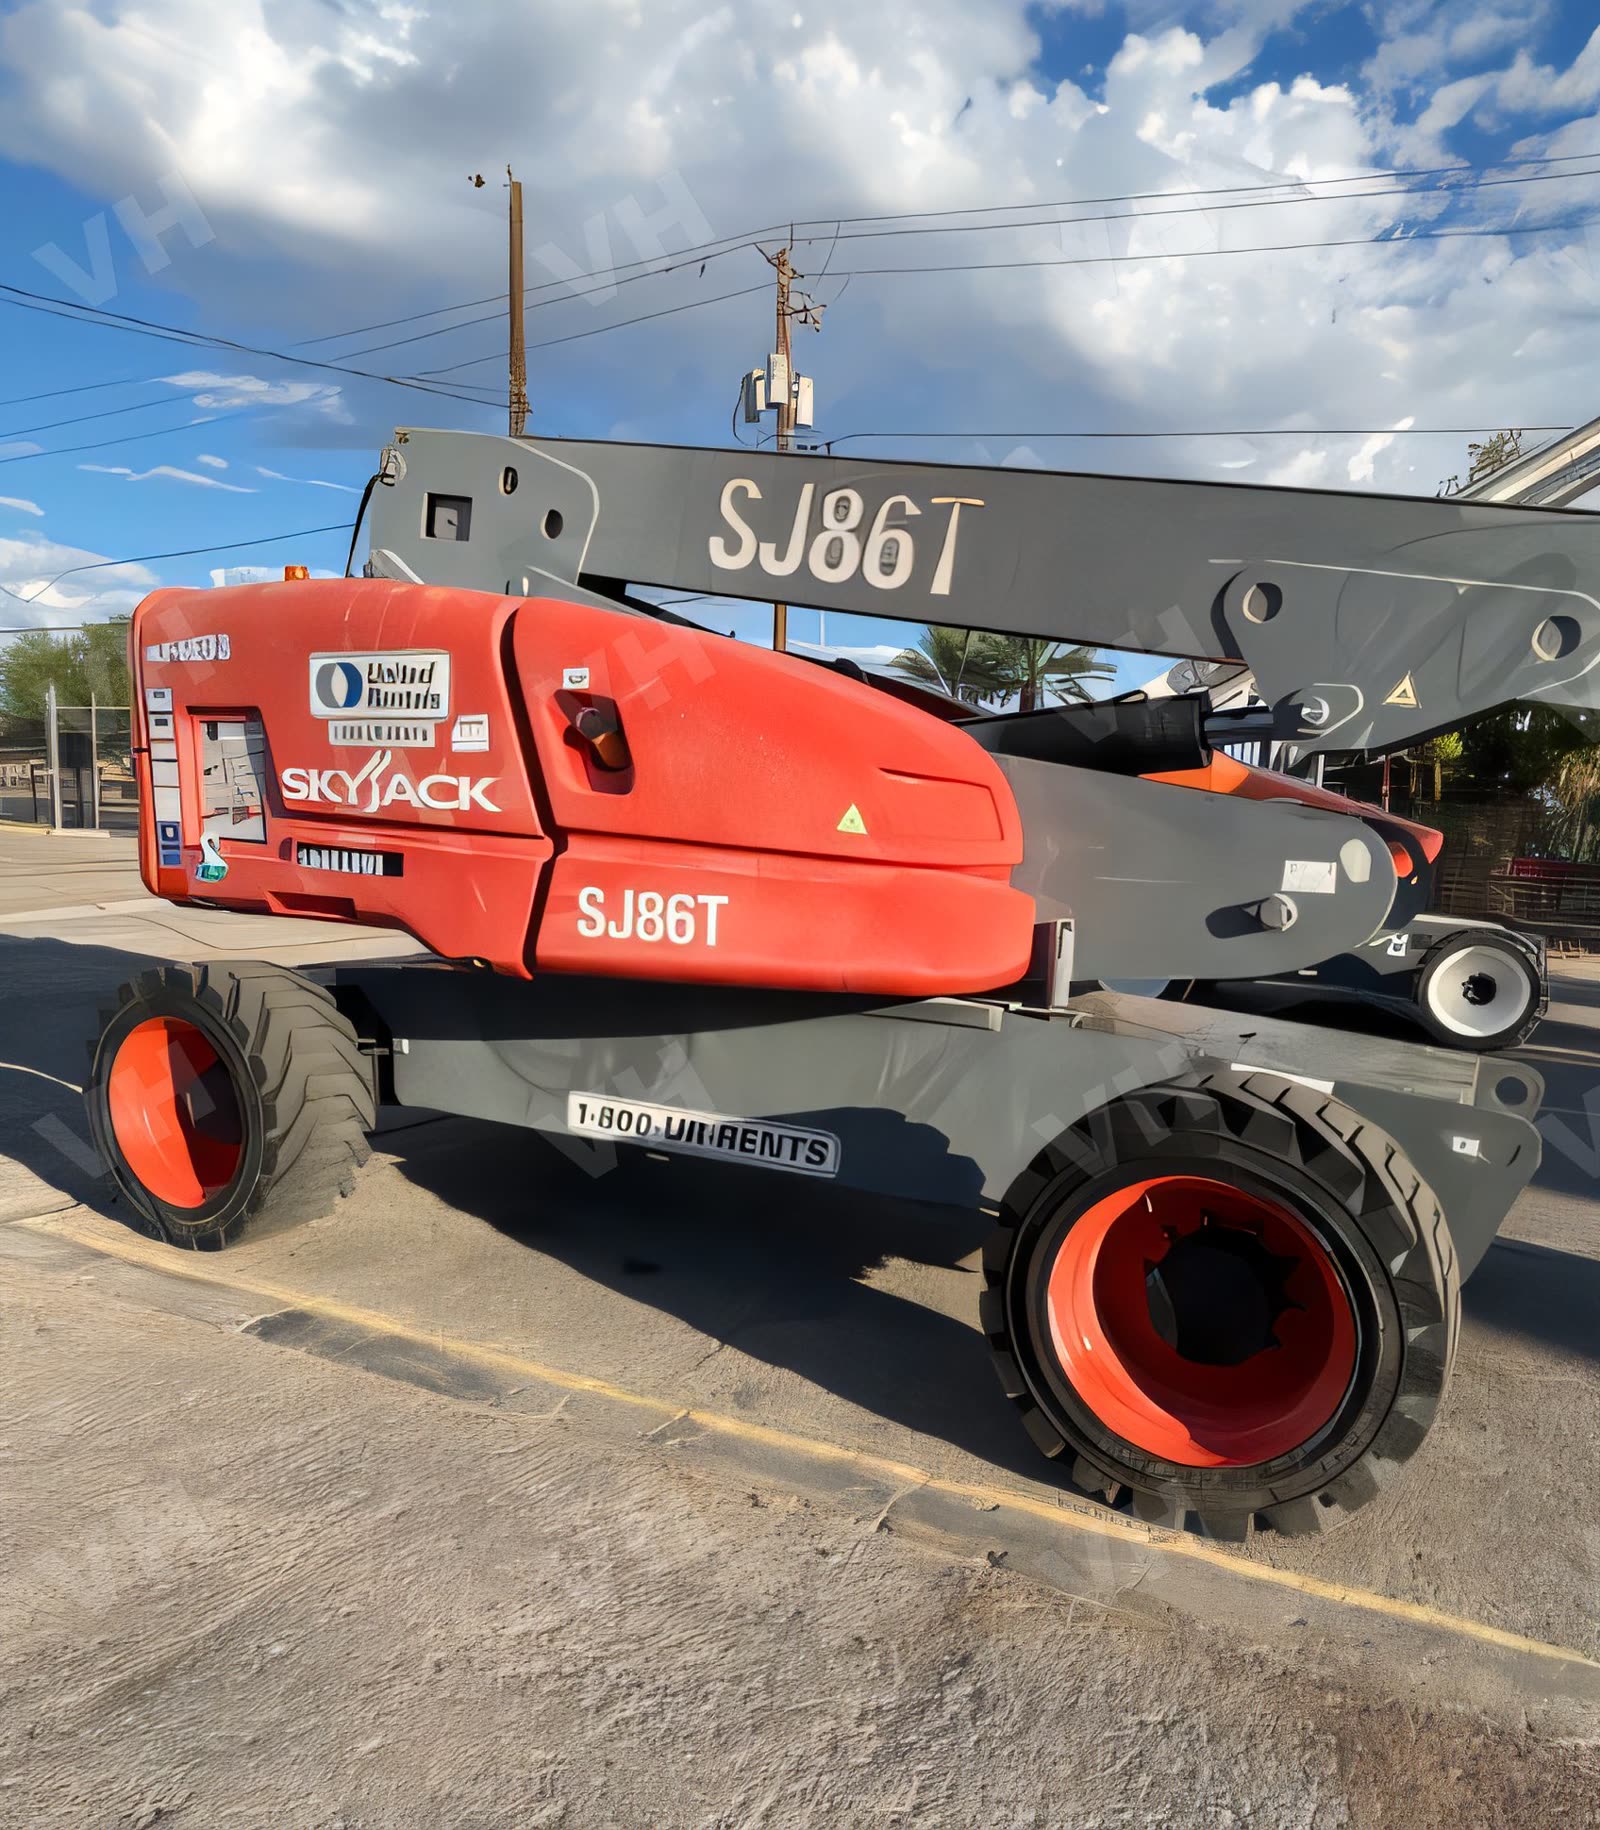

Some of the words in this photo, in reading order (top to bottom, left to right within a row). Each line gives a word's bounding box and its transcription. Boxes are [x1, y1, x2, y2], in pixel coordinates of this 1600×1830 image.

[708, 478, 985, 595] SJ86T
[281, 749, 502, 813] SKYJACK
[577, 886, 729, 946] SJ86T
